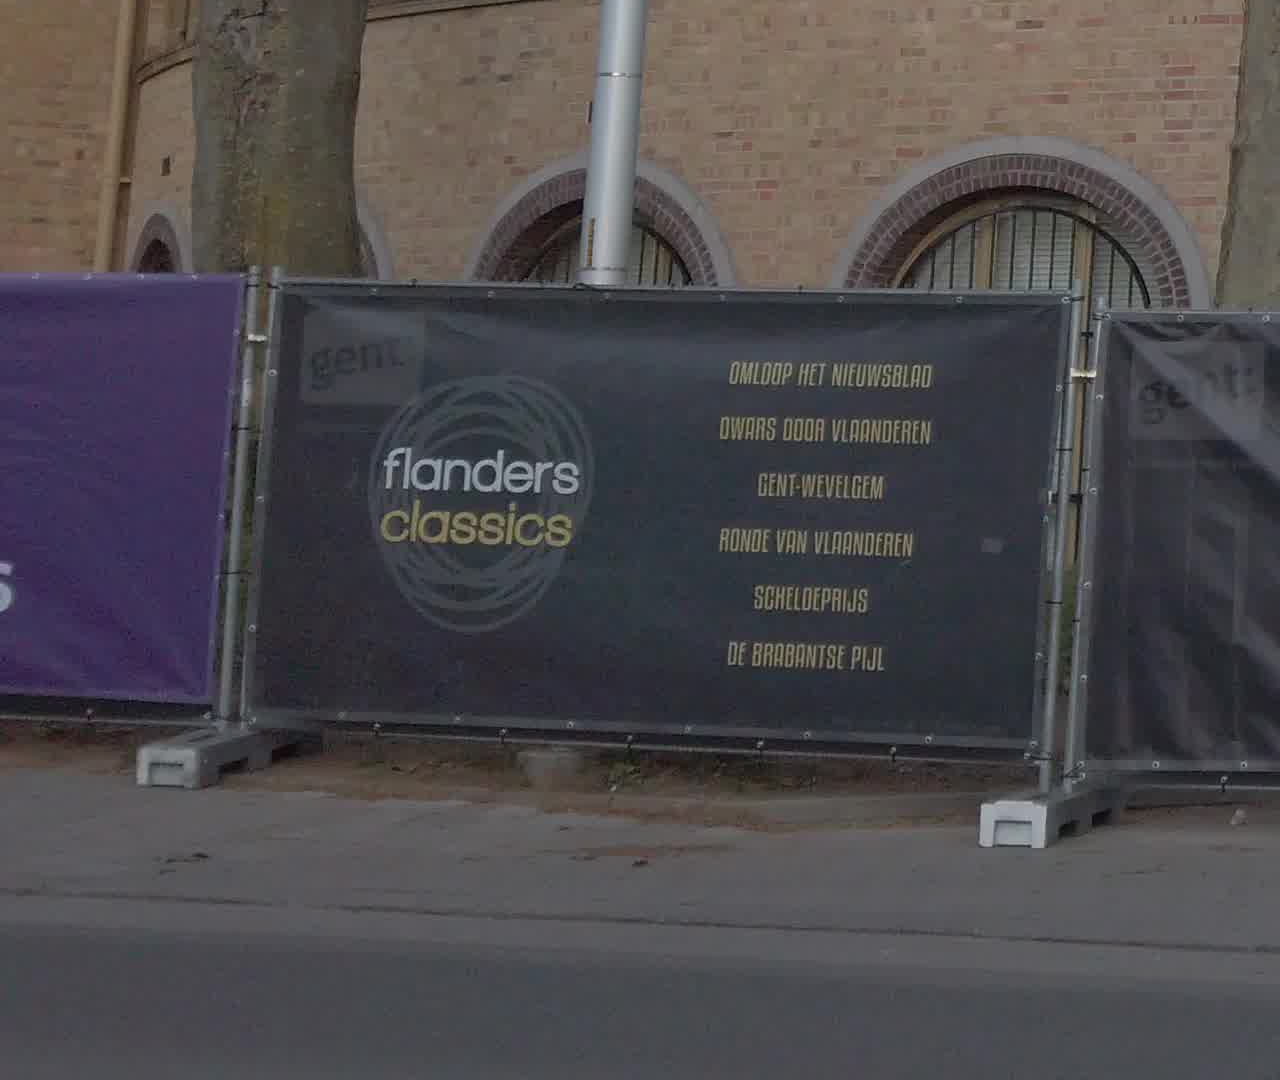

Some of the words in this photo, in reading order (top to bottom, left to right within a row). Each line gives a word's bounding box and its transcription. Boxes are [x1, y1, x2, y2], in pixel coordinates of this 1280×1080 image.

[729, 361, 793, 386] OMLOOP
[798, 362, 826, 387] HET
[831, 363, 933, 389] NIEUWSBLAD
[719, 417, 777, 442] DWARS
[783, 418, 825, 442] DOOR
[831, 419, 931, 445] VLAANDEREN
[383, 448, 580, 494] flanders
[757, 473, 885, 500] GENT-WEVELGEM
[380, 500, 574, 548] classics
[719, 528, 770, 553] RONDE
[775, 530, 808, 554] VAN
[814, 531, 914, 558] VLAANDEREN
[753, 585, 869, 613] SCHELDEPRIJS
[727, 641, 748, 666] DE
[751, 642, 846, 670] BRABANTSE
[850, 646, 886, 671] PIJL
